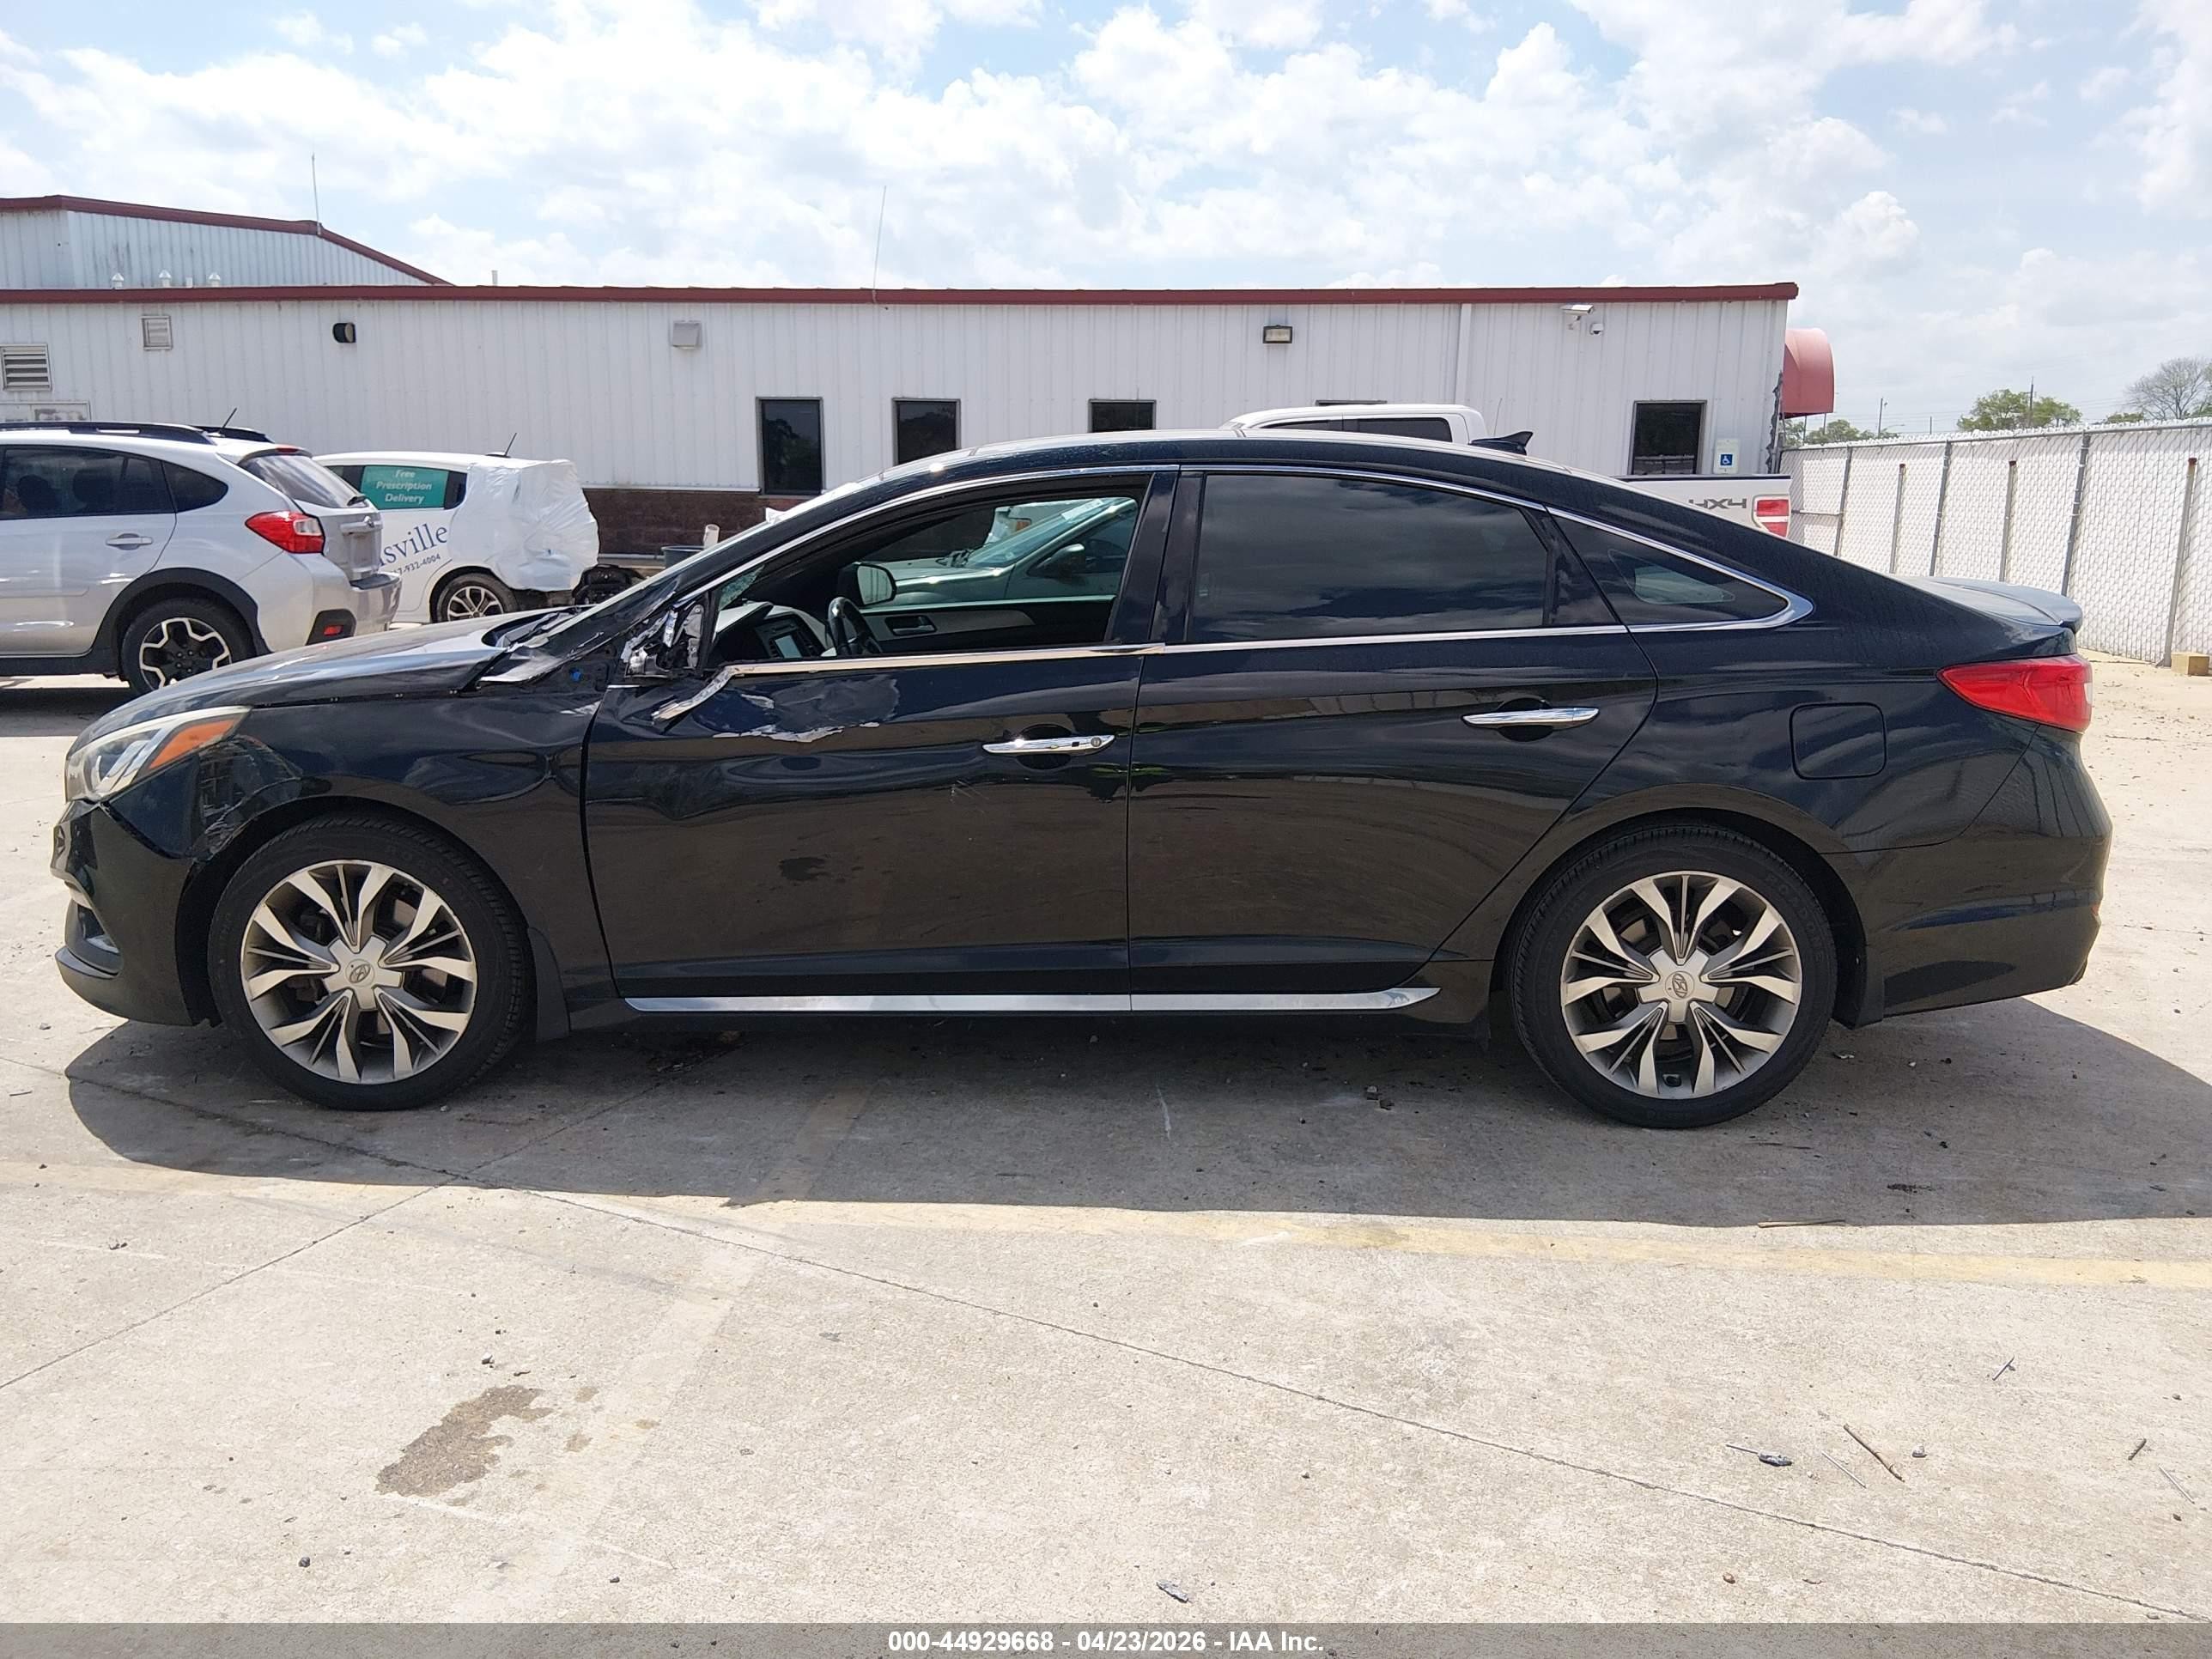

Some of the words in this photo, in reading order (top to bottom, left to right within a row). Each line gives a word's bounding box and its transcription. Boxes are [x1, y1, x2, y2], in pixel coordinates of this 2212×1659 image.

[395, 470, 416, 478] Free
[376, 481, 433, 492] Prescription
[385, 493, 425, 504] Delivery
[390, 553, 441, 575] 7-932-4004
